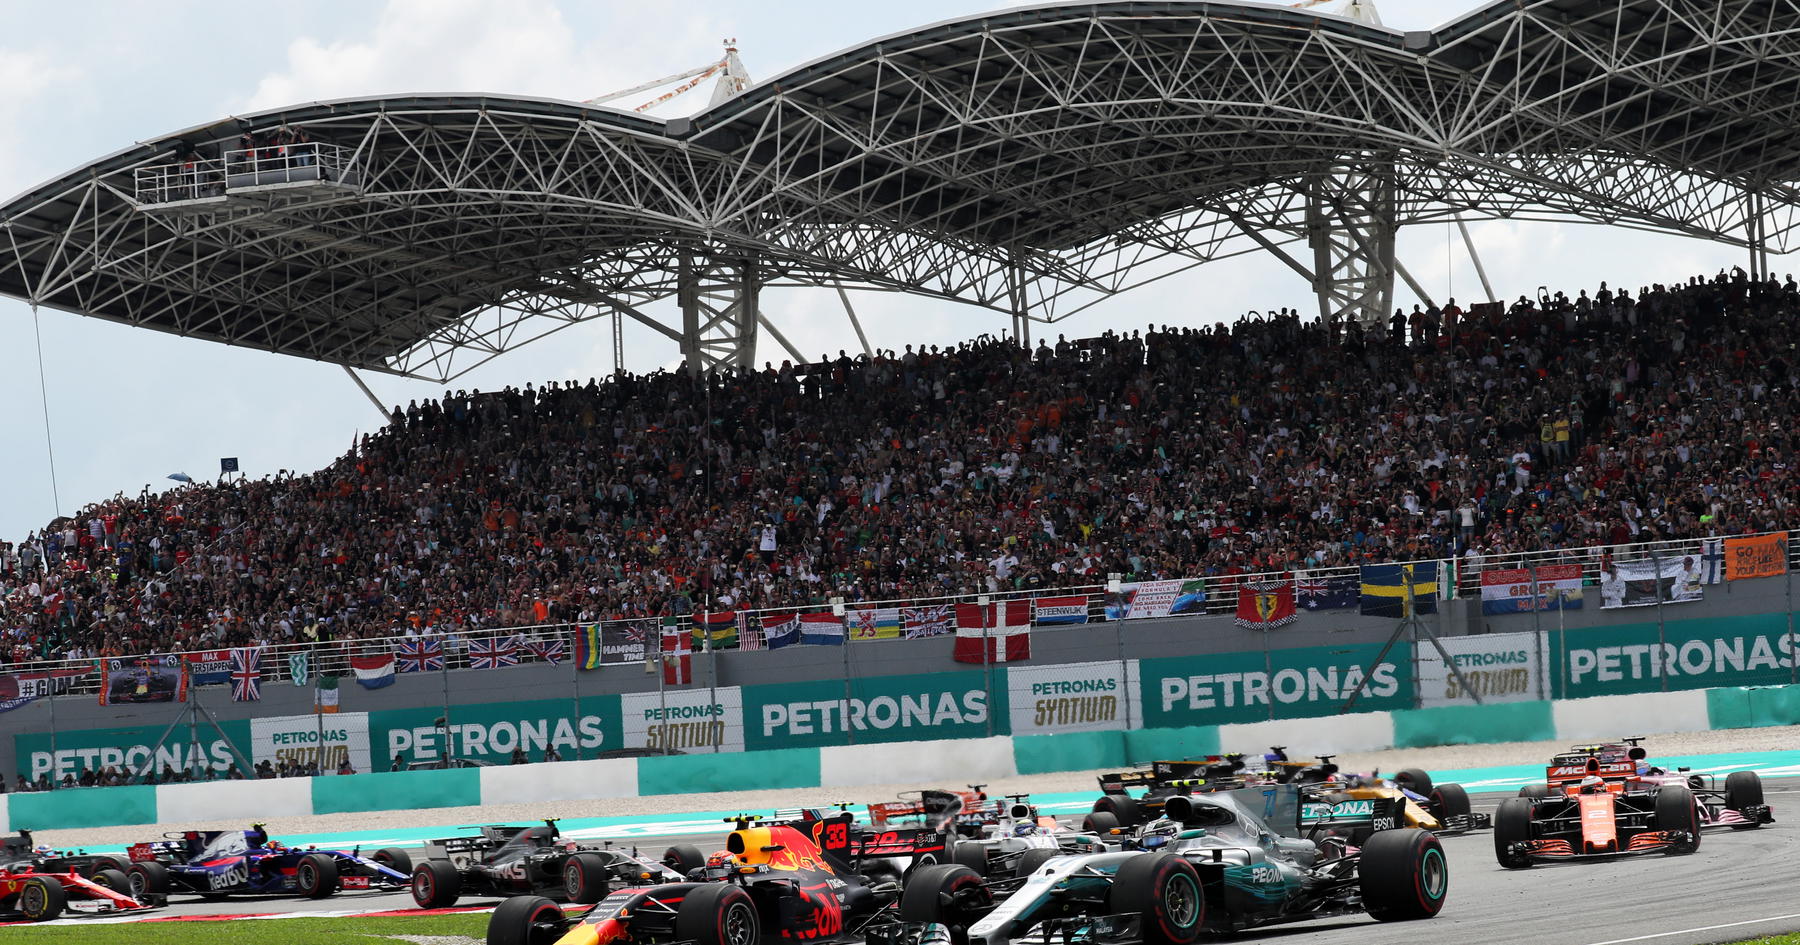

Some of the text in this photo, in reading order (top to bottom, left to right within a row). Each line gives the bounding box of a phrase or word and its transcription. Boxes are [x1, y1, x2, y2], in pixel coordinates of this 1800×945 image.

[1036, 606, 1083, 617] STEENWIJK
[201, 651, 219, 662] MAX
[602, 643, 645, 655] HAMMER
[623, 652, 645, 662] TIME
[1569, 633, 1800, 684] PETRONAS
[1032, 677, 1116, 696] PETRONAS
[1161, 662, 1399, 712] PETRONAS
[644, 703, 724, 721] PETRONAS
[762, 689, 988, 737] PETRONAS
[1033, 694, 1117, 727] SYNTIUM
[272, 729, 348, 745] PETRONAS
[388, 715, 604, 760] PETRONAS
[647, 720, 725, 750] SYNTIUM
[31, 740, 234, 783] PETRONAS
[1373, 816, 1395, 831] EPSON
[825, 823, 847, 850] 33
